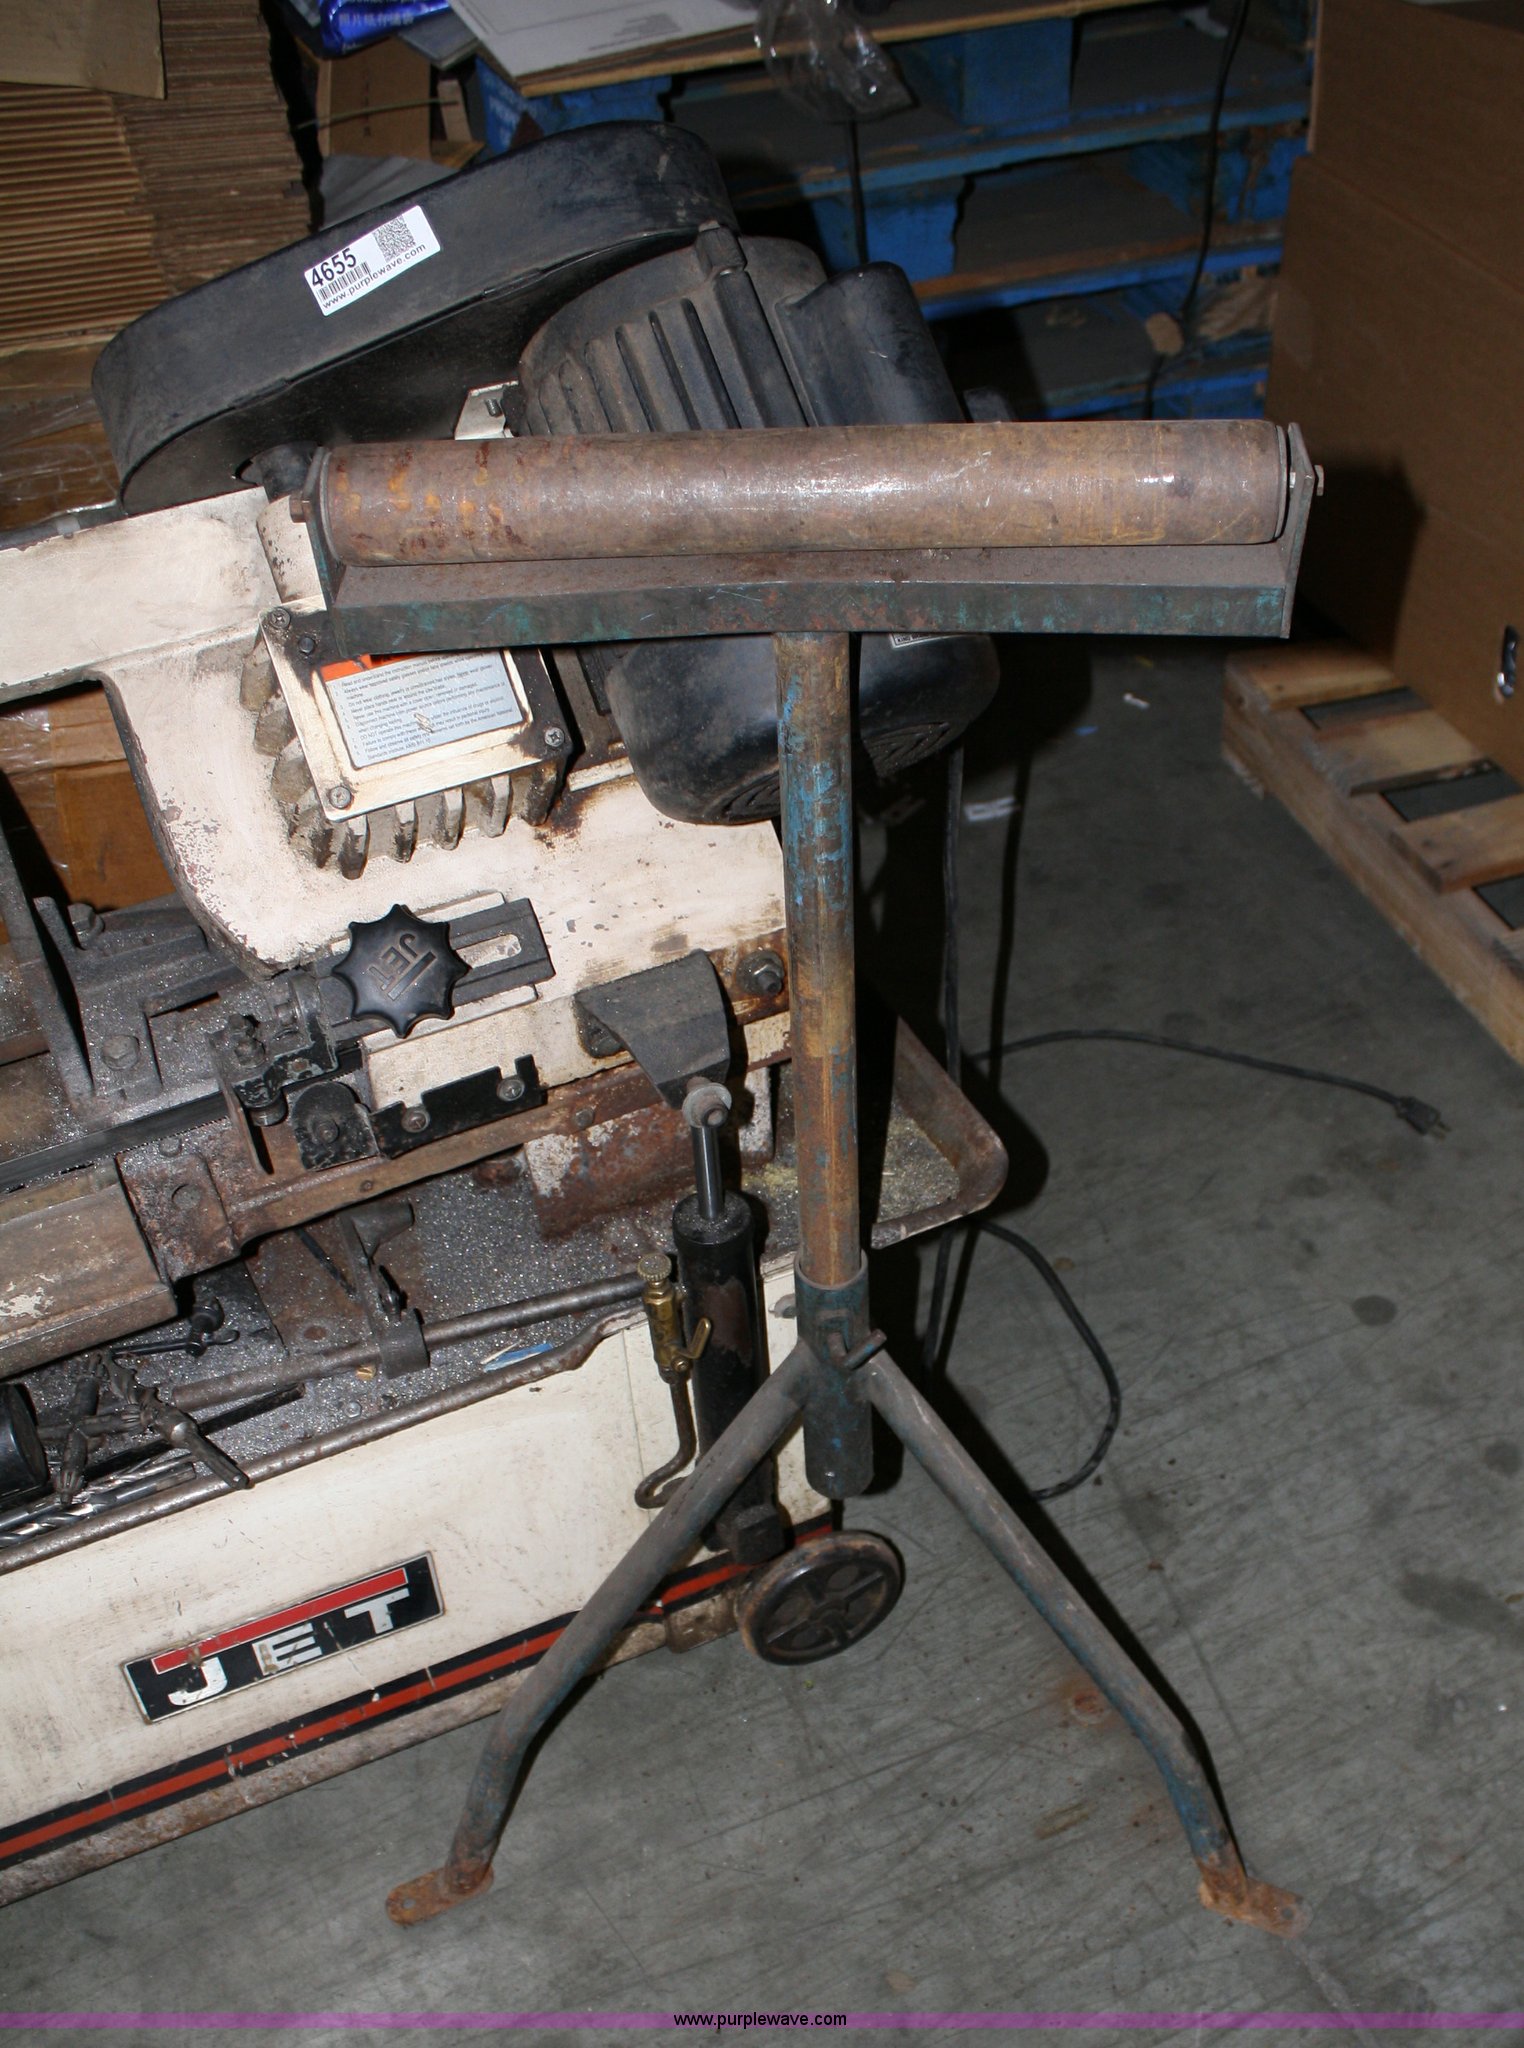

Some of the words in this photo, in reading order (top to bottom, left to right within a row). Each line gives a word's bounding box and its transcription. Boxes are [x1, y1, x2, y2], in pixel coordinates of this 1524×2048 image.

[311, 248, 357, 288] 4655
[322, 243, 427, 309] www.purplewave.com
[368, 933, 419, 992] JET
[168, 1588, 411, 1707] JET
